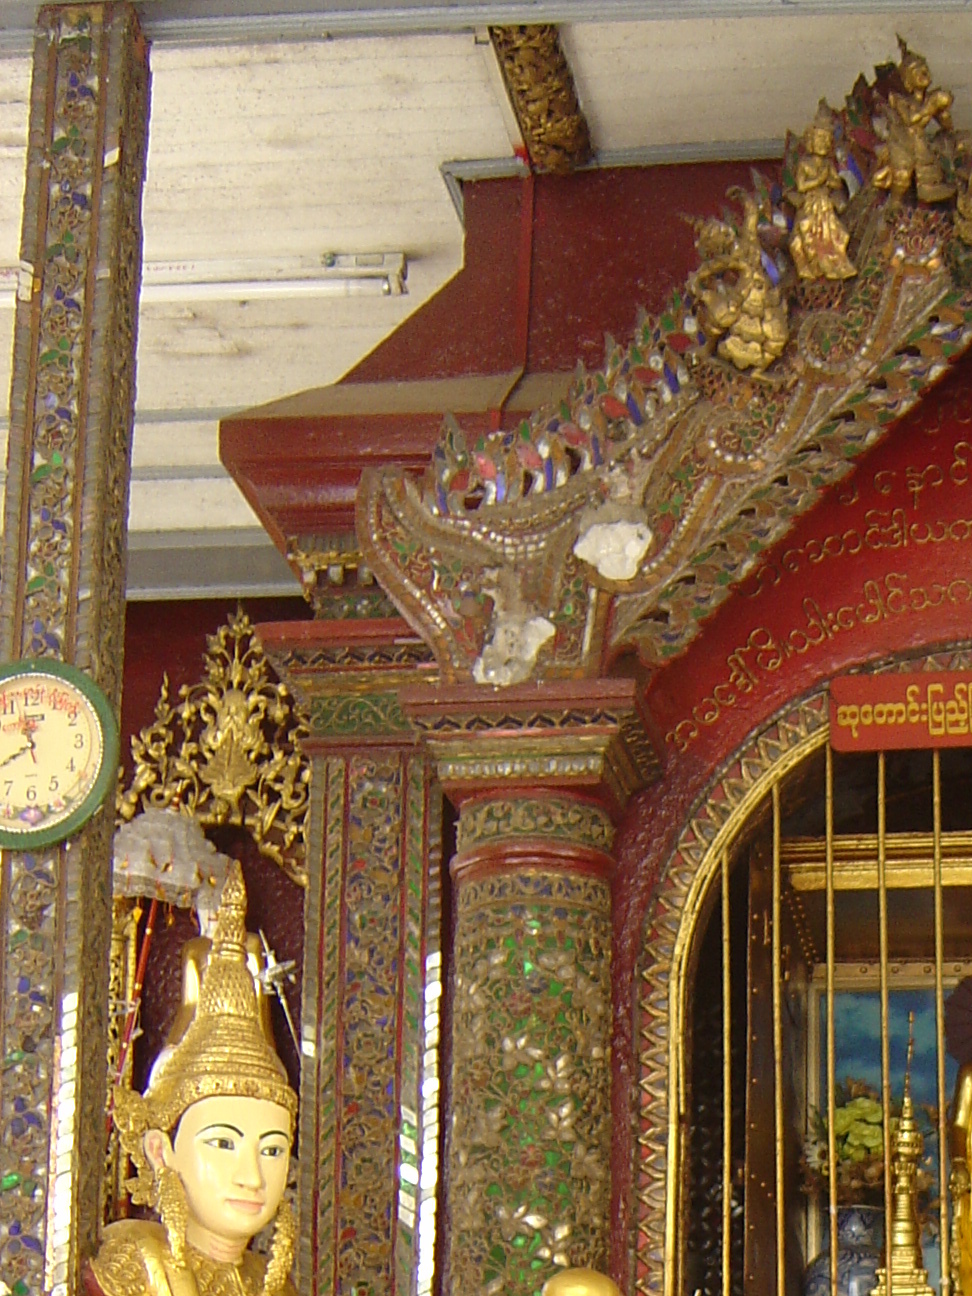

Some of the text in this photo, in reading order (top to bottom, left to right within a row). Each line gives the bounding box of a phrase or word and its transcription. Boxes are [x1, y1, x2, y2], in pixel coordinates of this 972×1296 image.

[73, 733, 84, 749] 3
[65, 756, 76, 773] 4
[3, 779, 14, 796] 7
[48, 775, 60, 792] 5
[26, 785, 37, 801] 6
